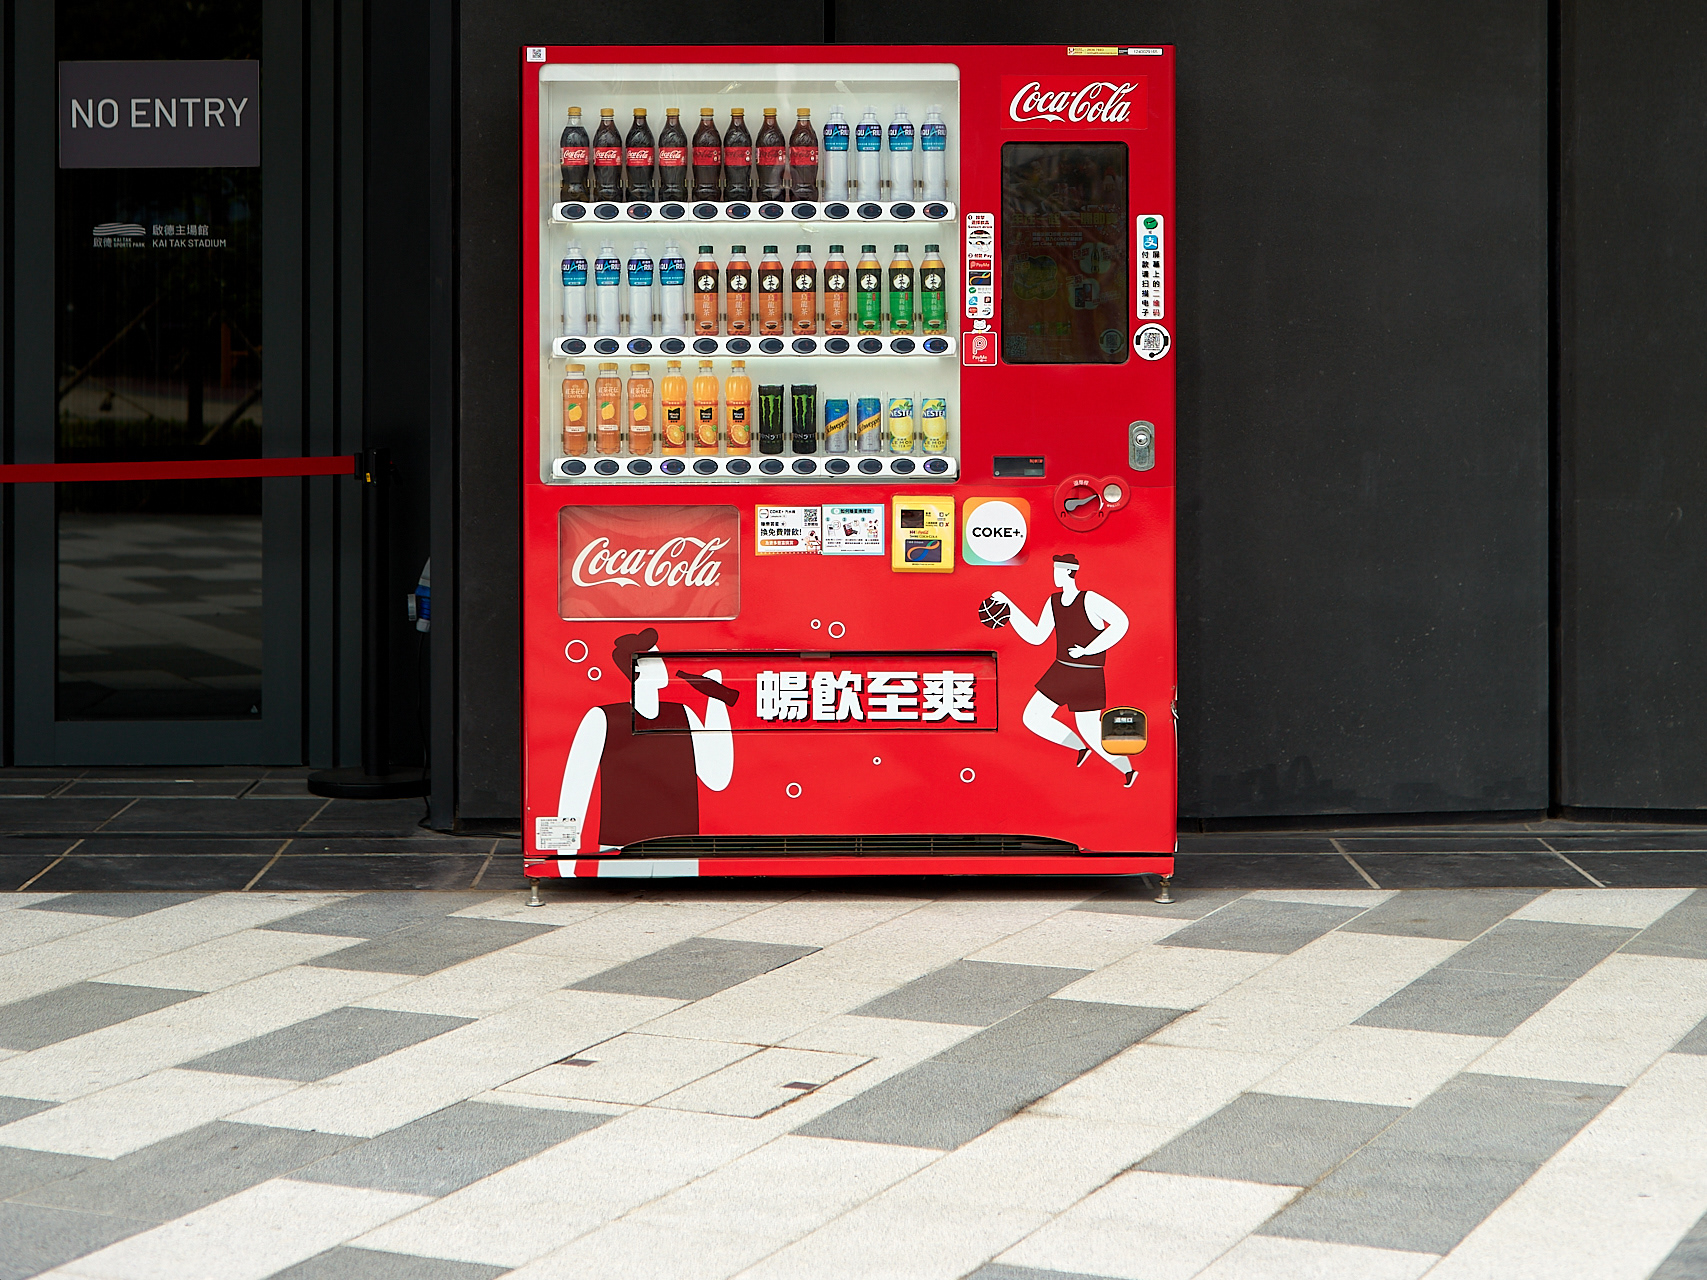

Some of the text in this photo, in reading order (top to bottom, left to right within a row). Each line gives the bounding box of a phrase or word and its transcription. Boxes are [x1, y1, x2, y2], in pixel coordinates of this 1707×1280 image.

[71, 97, 249, 128] NO ENTRY
[1009, 81, 1139, 123] Coca-Cola
[152, 239, 227, 248] KAI TAK STADIUM
[571, 536, 731, 588] Coca-Cola
[756, 670, 977, 723] 暢飲至爽
